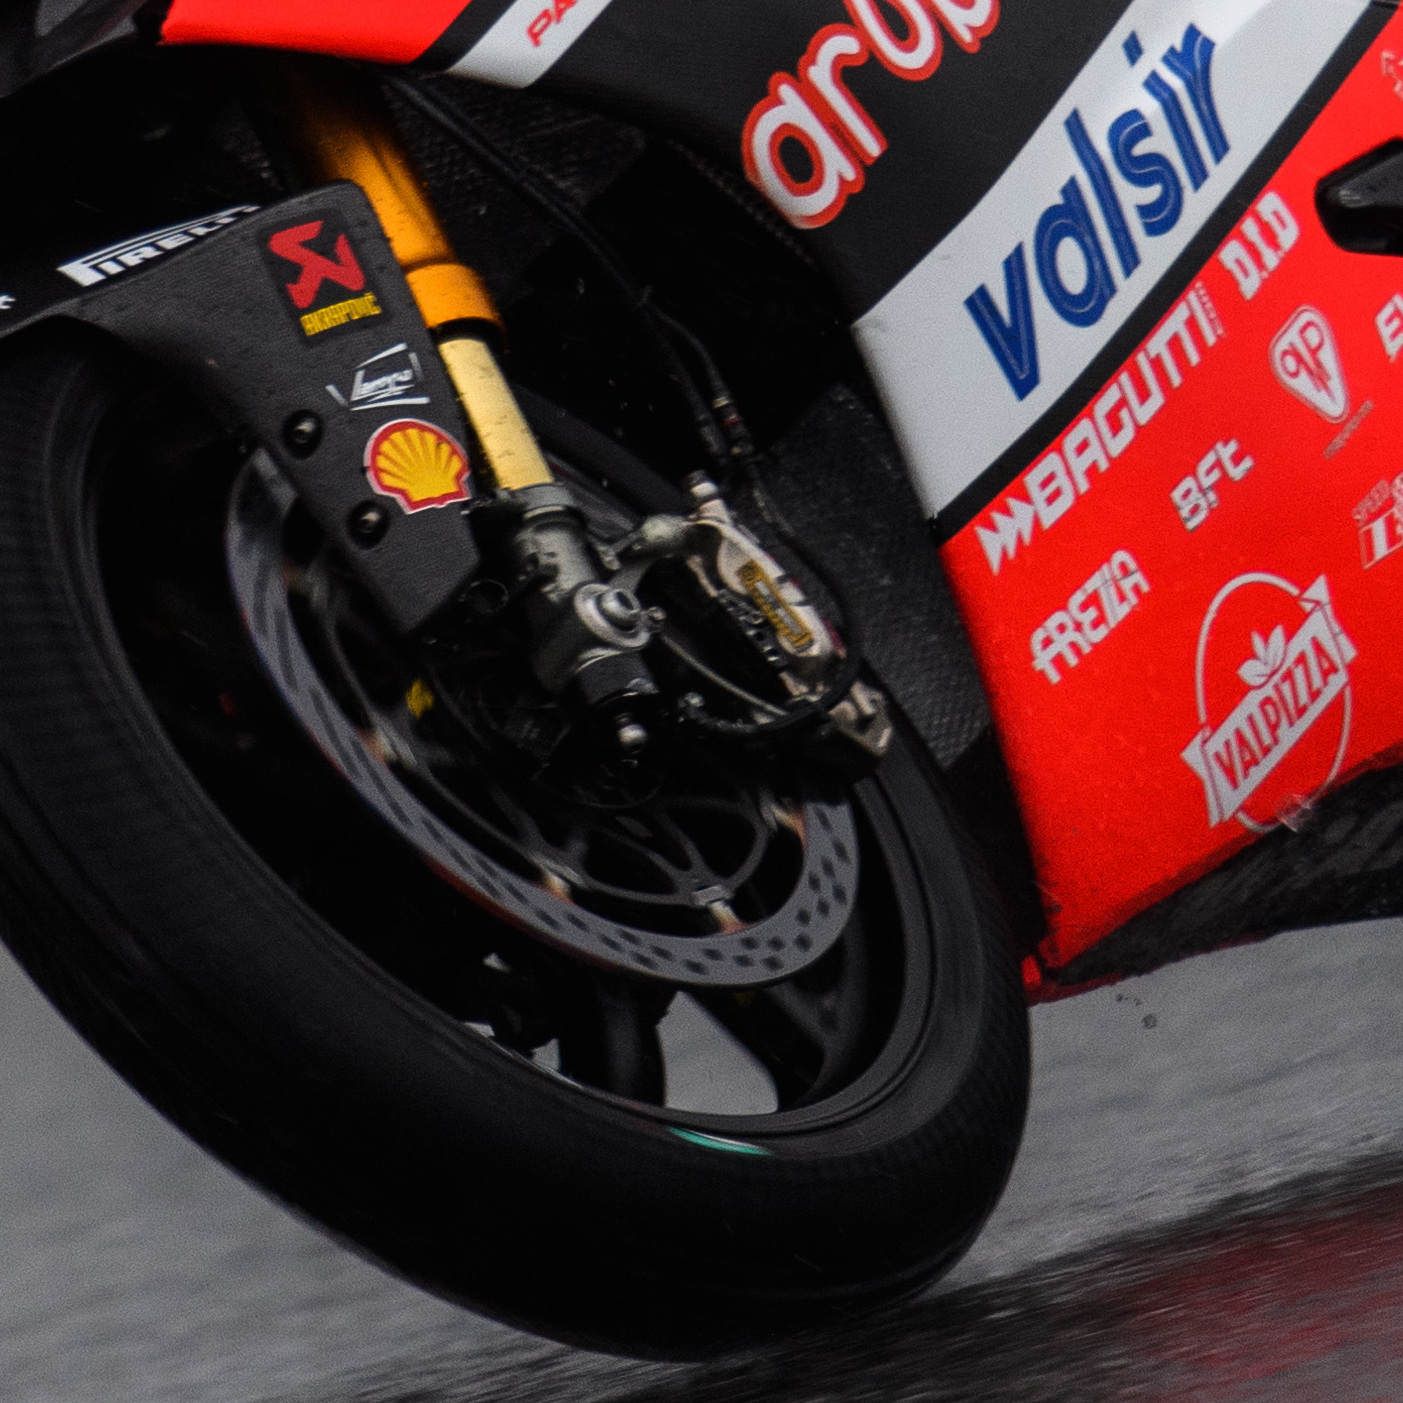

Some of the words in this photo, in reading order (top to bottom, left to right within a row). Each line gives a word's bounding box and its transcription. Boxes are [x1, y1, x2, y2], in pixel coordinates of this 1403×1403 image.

[963, 22, 1232, 402] valsir
[1023, 289, 1216, 531] BAGUTTI
[1212, 634, 1340, 792] VALPIZZA
